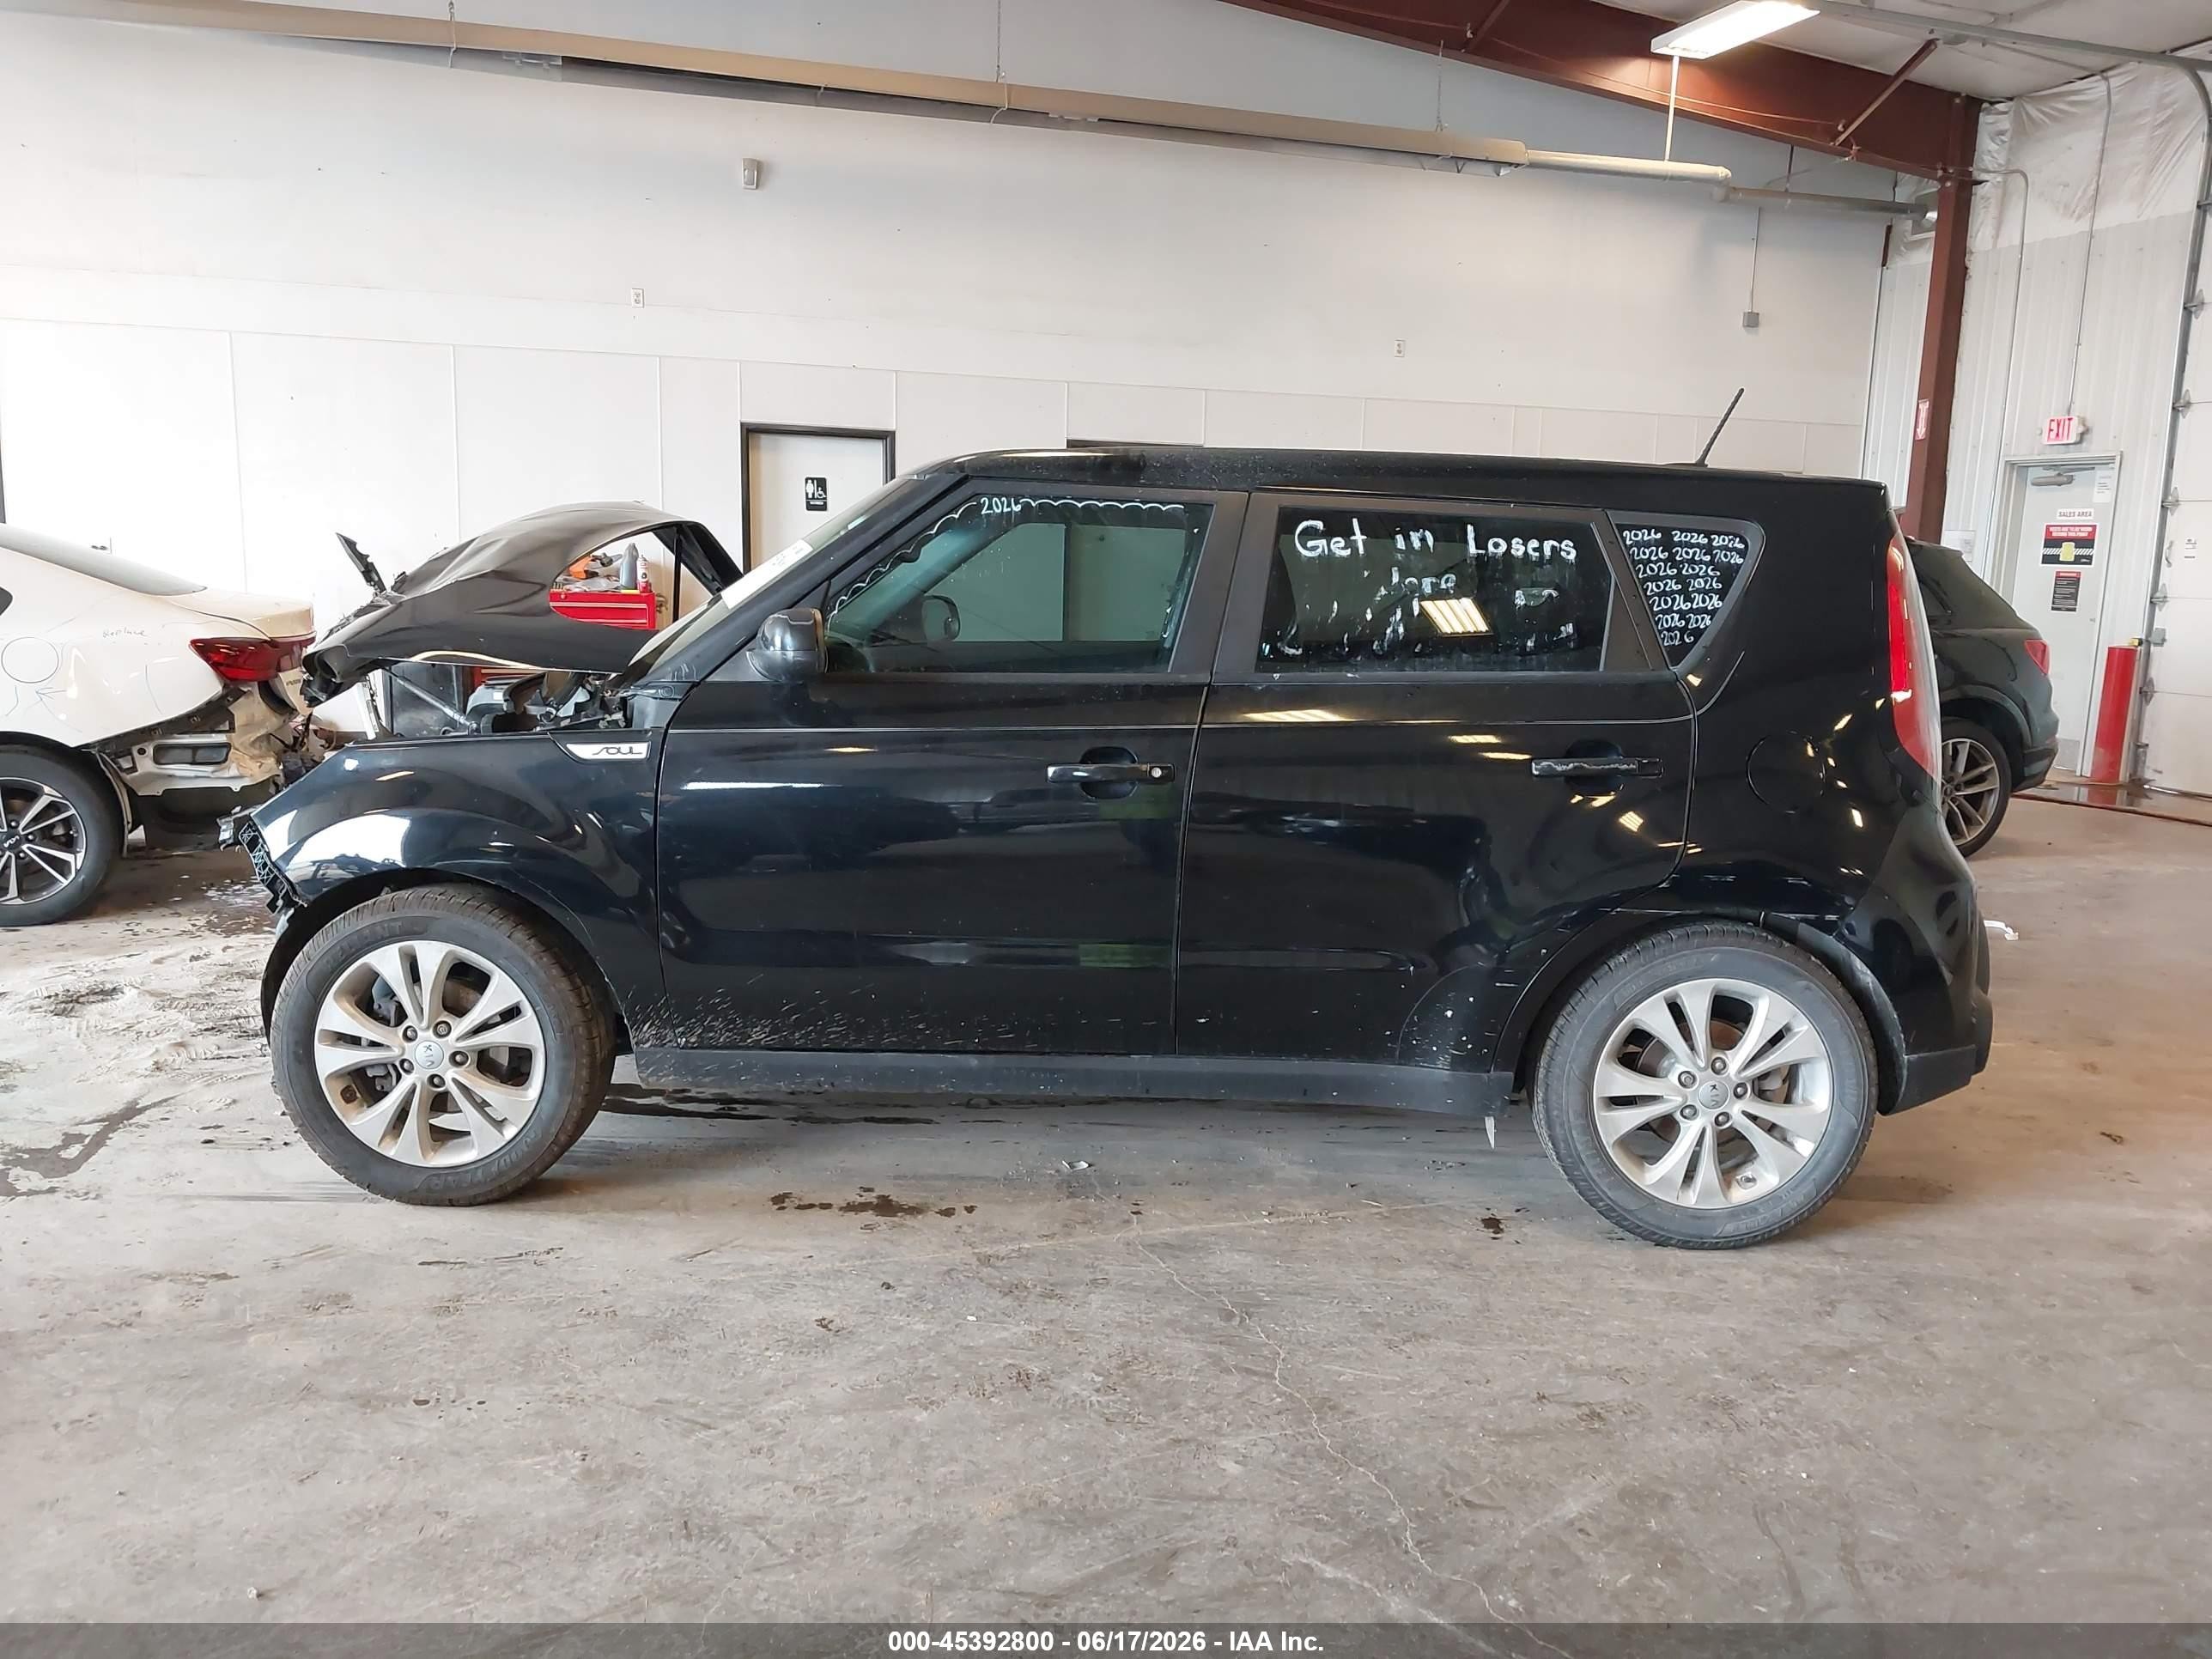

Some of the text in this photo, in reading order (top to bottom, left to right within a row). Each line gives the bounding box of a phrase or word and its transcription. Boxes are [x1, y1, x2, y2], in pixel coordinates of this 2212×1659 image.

[2047, 417, 2074, 441] EXIT
[981, 497, 1022, 514] 2026
[1294, 518, 1577, 562] Get in Losers
[1623, 529, 1745, 549] 2026 2026 2026
[1630, 547, 1744, 564] 2026 2026 2026
[1636, 562, 1720, 578] 2026 2026
[1644, 577, 1722, 595] 2026 2026
[1649, 593, 1723, 611] 2026 2026
[1656, 613, 1711, 629] 2026 2026
[1661, 631, 1694, 646] 2026
[592, 746, 643, 756] SOUL
[422, 1043, 435, 1068] KIA
[1709, 1083, 1721, 1107] KIA
